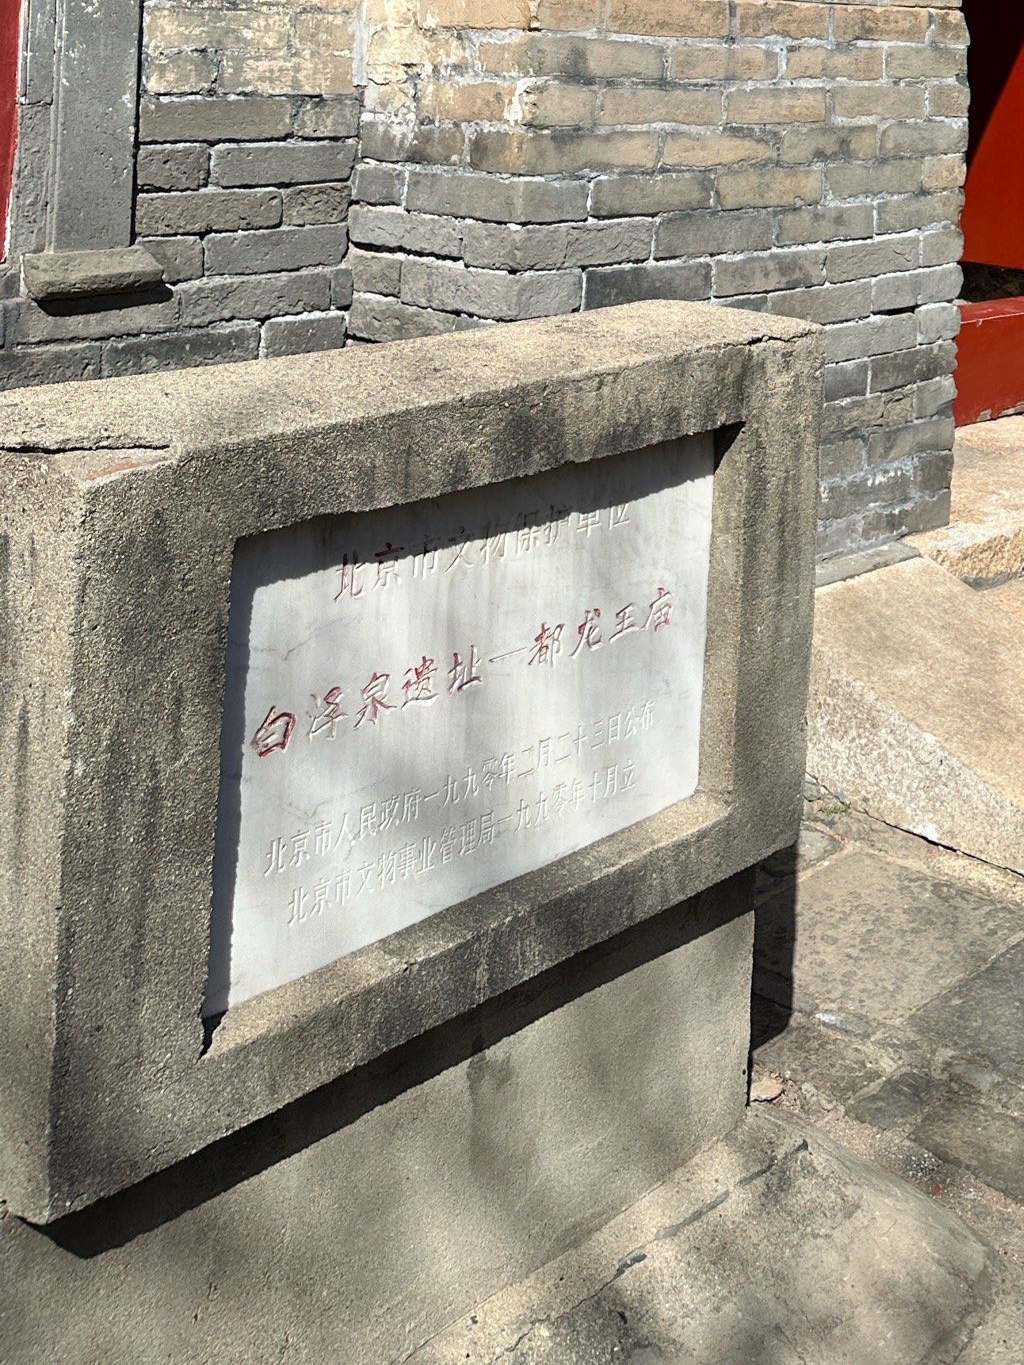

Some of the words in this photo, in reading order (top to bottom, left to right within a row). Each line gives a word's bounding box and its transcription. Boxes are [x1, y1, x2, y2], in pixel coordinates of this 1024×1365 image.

[263, 699, 657, 877] 北京市人民政府一九九零年二月二十三日公布
[286, 758, 638, 927] 北京市文物事业管理局一九九零年十月立
